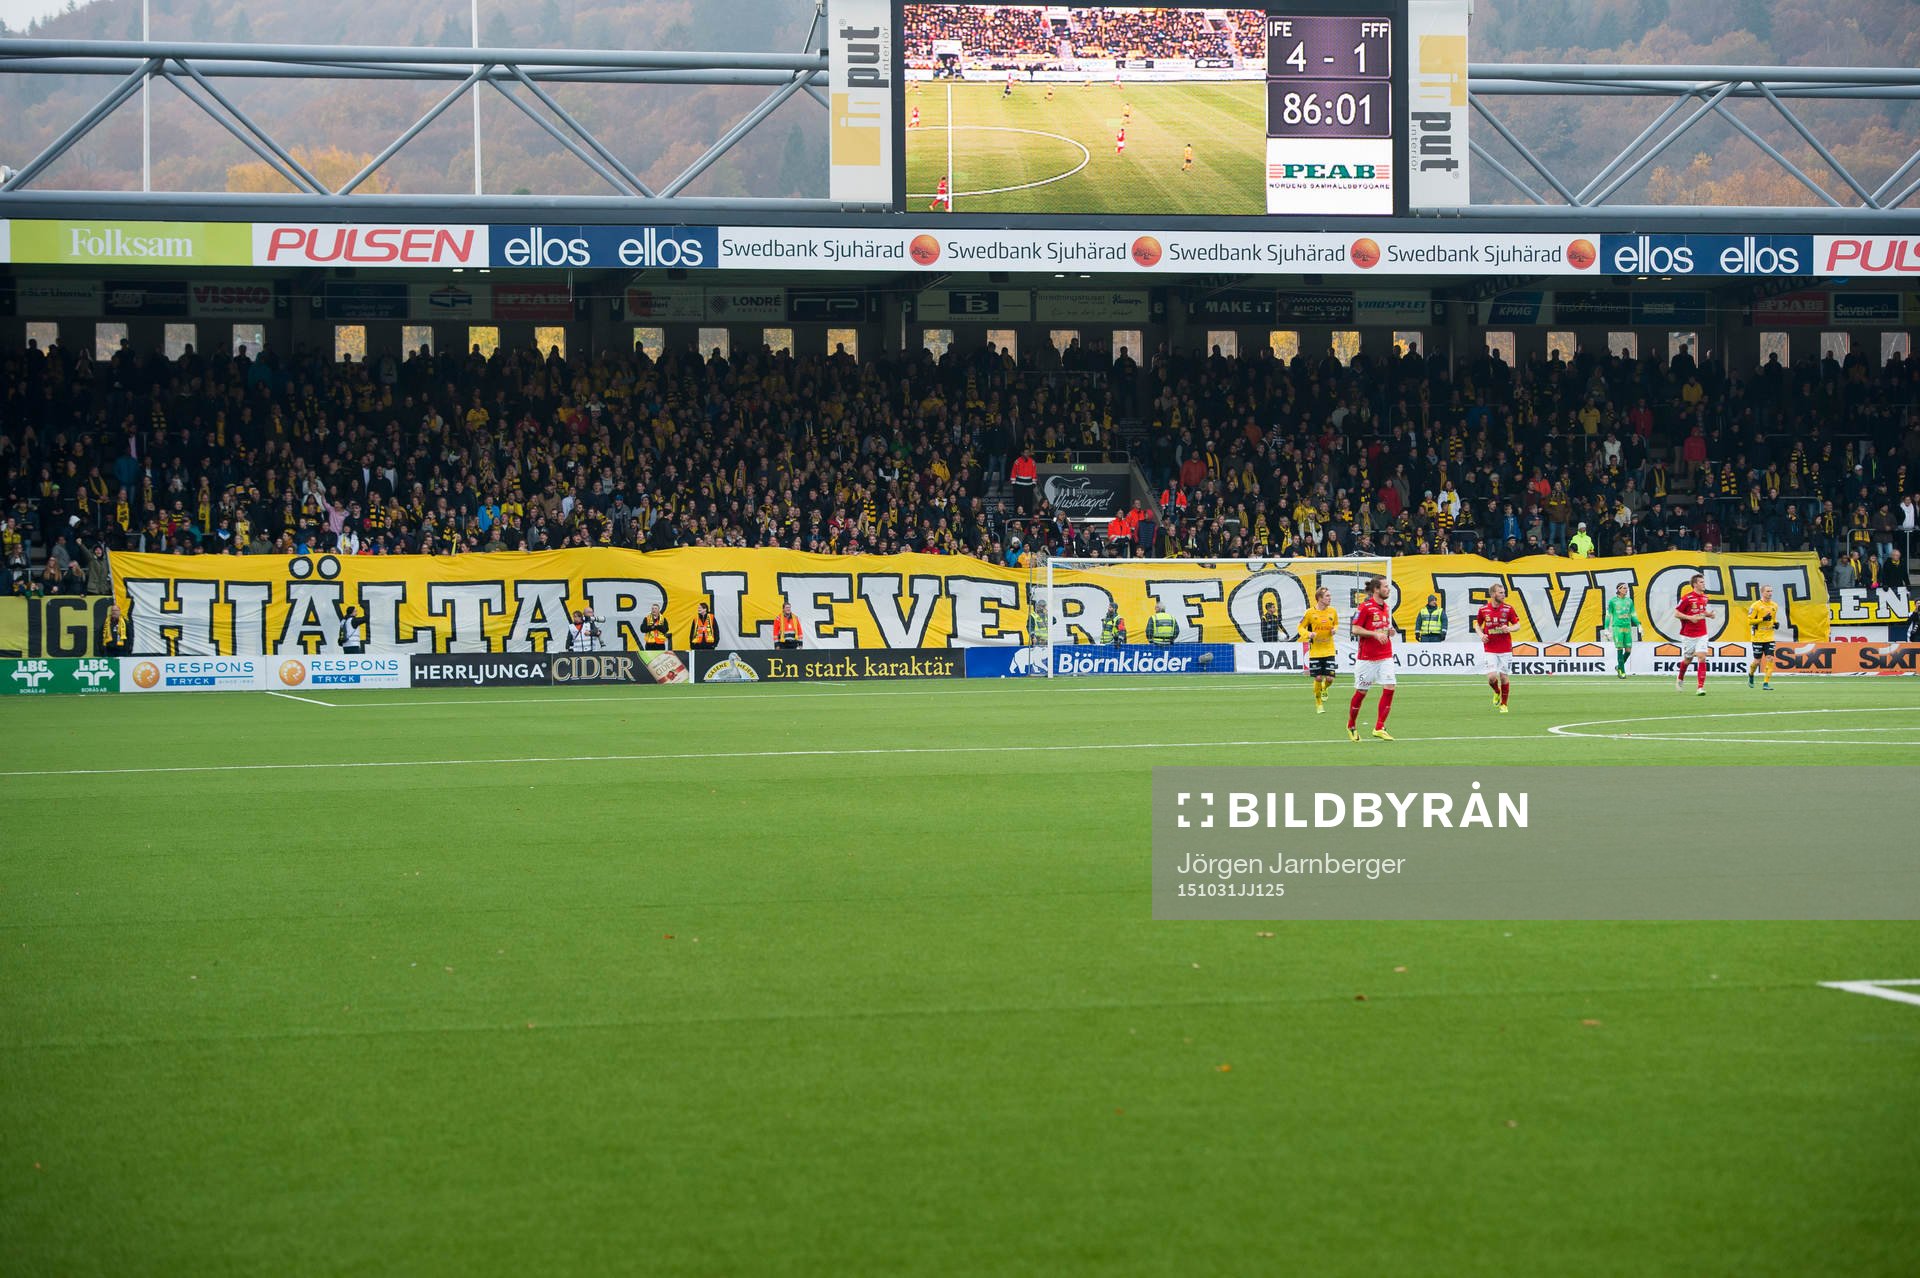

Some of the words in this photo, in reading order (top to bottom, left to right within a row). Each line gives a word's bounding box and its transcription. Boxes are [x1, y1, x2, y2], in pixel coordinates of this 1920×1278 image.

[1269, 22, 1292, 37] IFE
[1362, 23, 1388, 38] FFF
[1286, 41, 1307, 73] 4
[1354, 43, 1366, 73] 1
[1283, 92, 1371, 125] 86:01
[1282, 164, 1375, 179] PEAB
[70, 228, 193, 257] Folksam
[266, 228, 475, 262] PULSEN
[504, 227, 590, 266] ellos
[618, 228, 703, 267] ellos
[722, 239, 817, 258] Swedbank
[823, 239, 904, 262] Sjuhärad
[947, 241, 1042, 259] Swedbank
[1047, 241, 1126, 264] Sjuhärad
[1169, 243, 1261, 261] Swedbank
[1267, 243, 1345, 265] Sjuhärad
[1614, 235, 1693, 273] ellos
[1387, 244, 1479, 262] Swedbank
[1484, 244, 1561, 266] Sjuhärad
[1720, 236, 1799, 274] ellos
[1826, 240, 1920, 271] PUL
[1206, 302, 1252, 313] MAKE
[1499, 306, 1532, 316] KPMG
[702, 571, 1114, 649] LEVER
[17, 660, 47, 672] LBC
[79, 659, 109, 671] LBC
[165, 662, 254, 673] RESPONS
[312, 660, 399, 671] RESPONS
[553, 656, 636, 682] CIDER
[767, 658, 800, 678] En
[805, 656, 858, 678] stark
[864, 655, 954, 676] karaktär
[1059, 651, 1192, 673] Björnkläder
[1407, 650, 1475, 667] DÖRRAR
